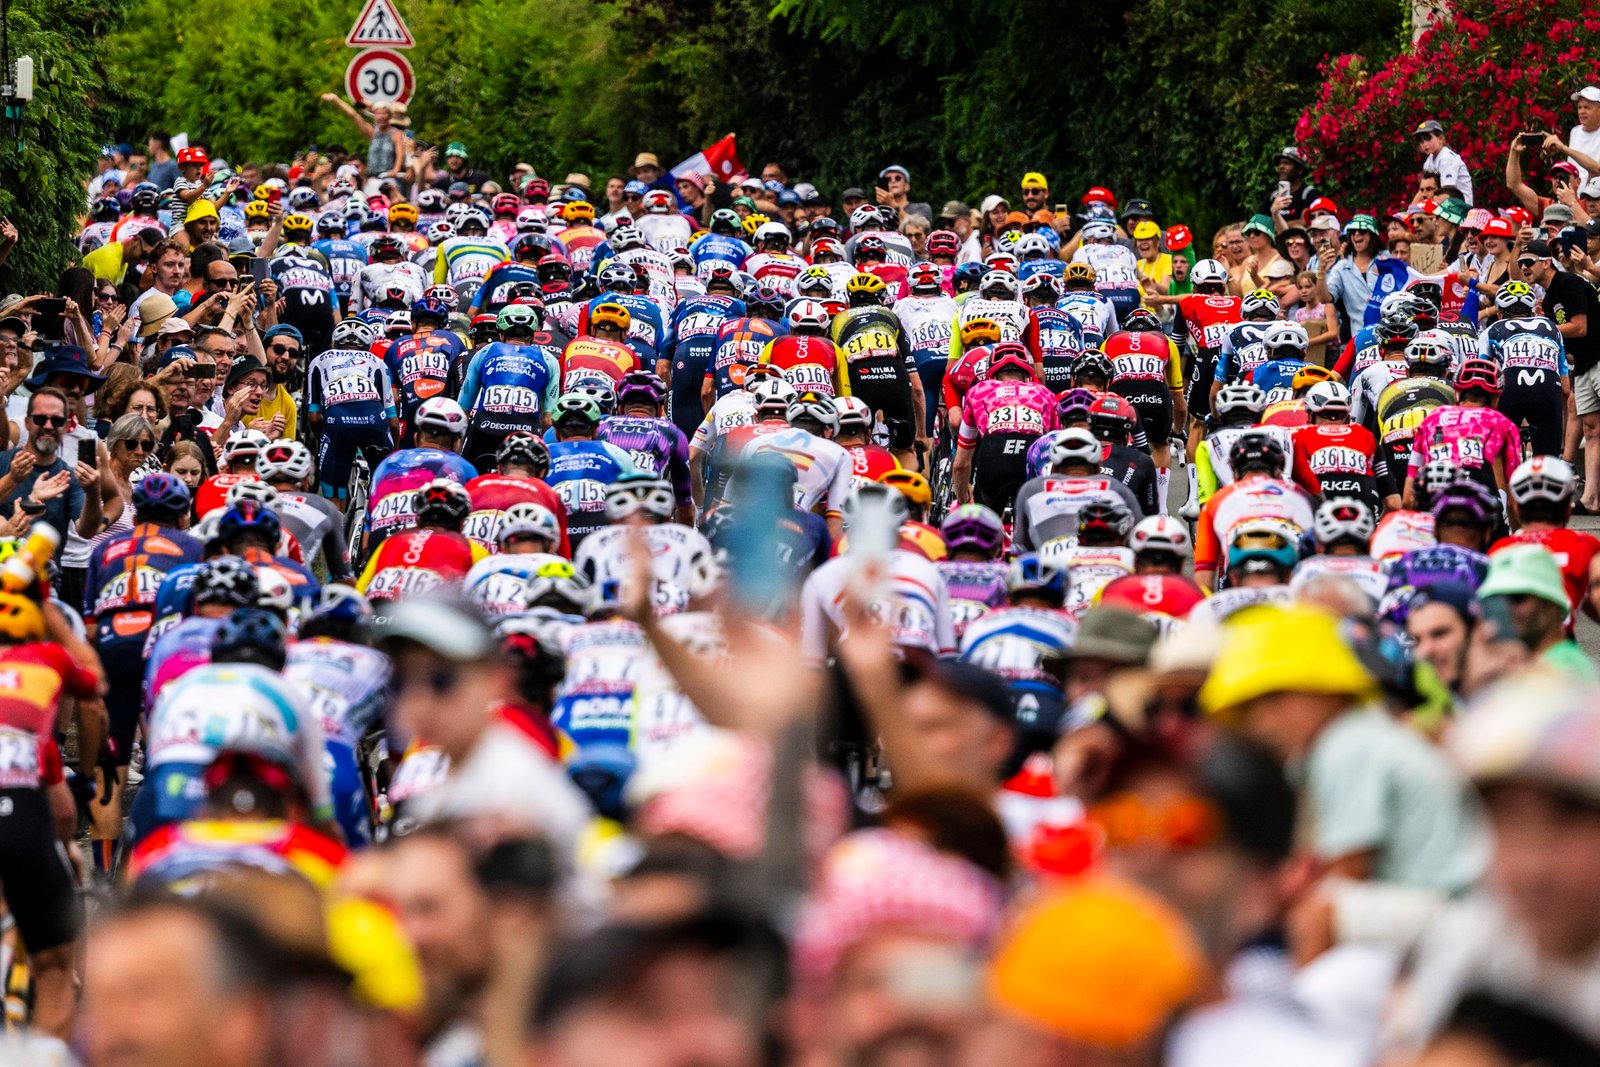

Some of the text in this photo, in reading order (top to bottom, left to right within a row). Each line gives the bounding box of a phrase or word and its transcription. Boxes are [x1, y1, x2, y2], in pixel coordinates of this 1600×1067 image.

[364, 70, 399, 96] 30
[682, 316, 698, 332] 27
[1059, 334, 1077, 349] 26
[1242, 349, 1265, 364] 142
[1360, 348, 1378, 360] 94
[1507, 342, 1529, 358] 144
[425, 355, 447, 371] 191
[1355, 360, 1379, 372] VELU
[495, 366, 537, 380] MONDIALE
[1517, 369, 1545, 386] M
[328, 380, 346, 396] 51
[357, 378, 374, 393] 51
[485, 387, 512, 406] 157
[1125, 394, 1163, 404] Cofidis
[1270, 391, 1287, 404] 91
[991, 407, 1012, 425] 33
[490, 421, 532, 432] DECATHLON
[1003, 439, 1026, 454] EF
[553, 453, 612, 465] DECATHLON
[1312, 450, 1337, 468] 136
[1340, 450, 1365, 468] 136
[555, 464, 601, 474] MONDIALE
[1321, 481, 1361, 492] RKEA
